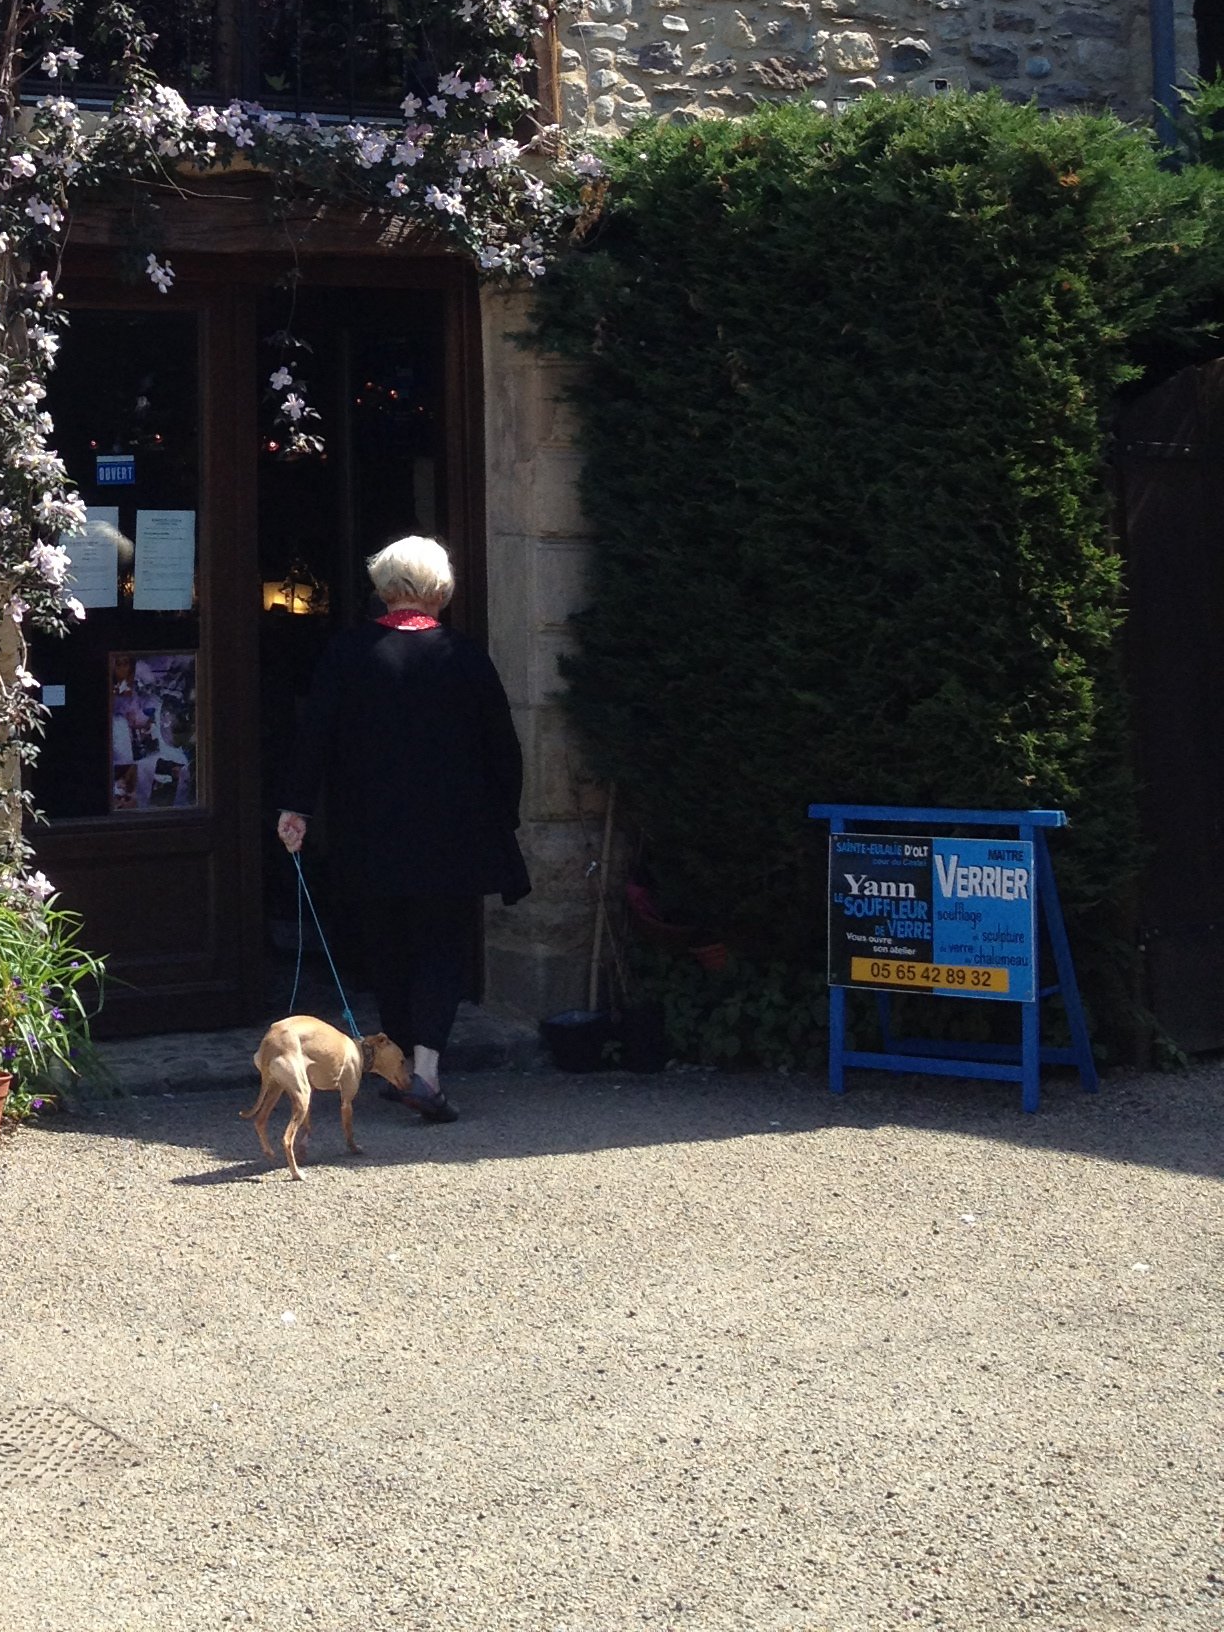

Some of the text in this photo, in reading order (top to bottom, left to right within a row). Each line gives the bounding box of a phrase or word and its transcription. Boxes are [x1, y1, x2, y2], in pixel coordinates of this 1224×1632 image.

[98, 466, 134, 481] OUVERT
[904, 844, 929, 858] D'OLT
[843, 873, 916, 898] Yann
[833, 892, 928, 920] LE SOUFFLEUR
[846, 932, 892, 945] Vous ouvre
[874, 919, 932, 940] DE VERRE
[982, 922, 1024, 950] sculpture
[873, 945, 916, 956] son atelier
[949, 944, 974, 953] verre
[974, 945, 1029, 967] chalumeau
[870, 962, 992, 987] 05 65 42 89 32
